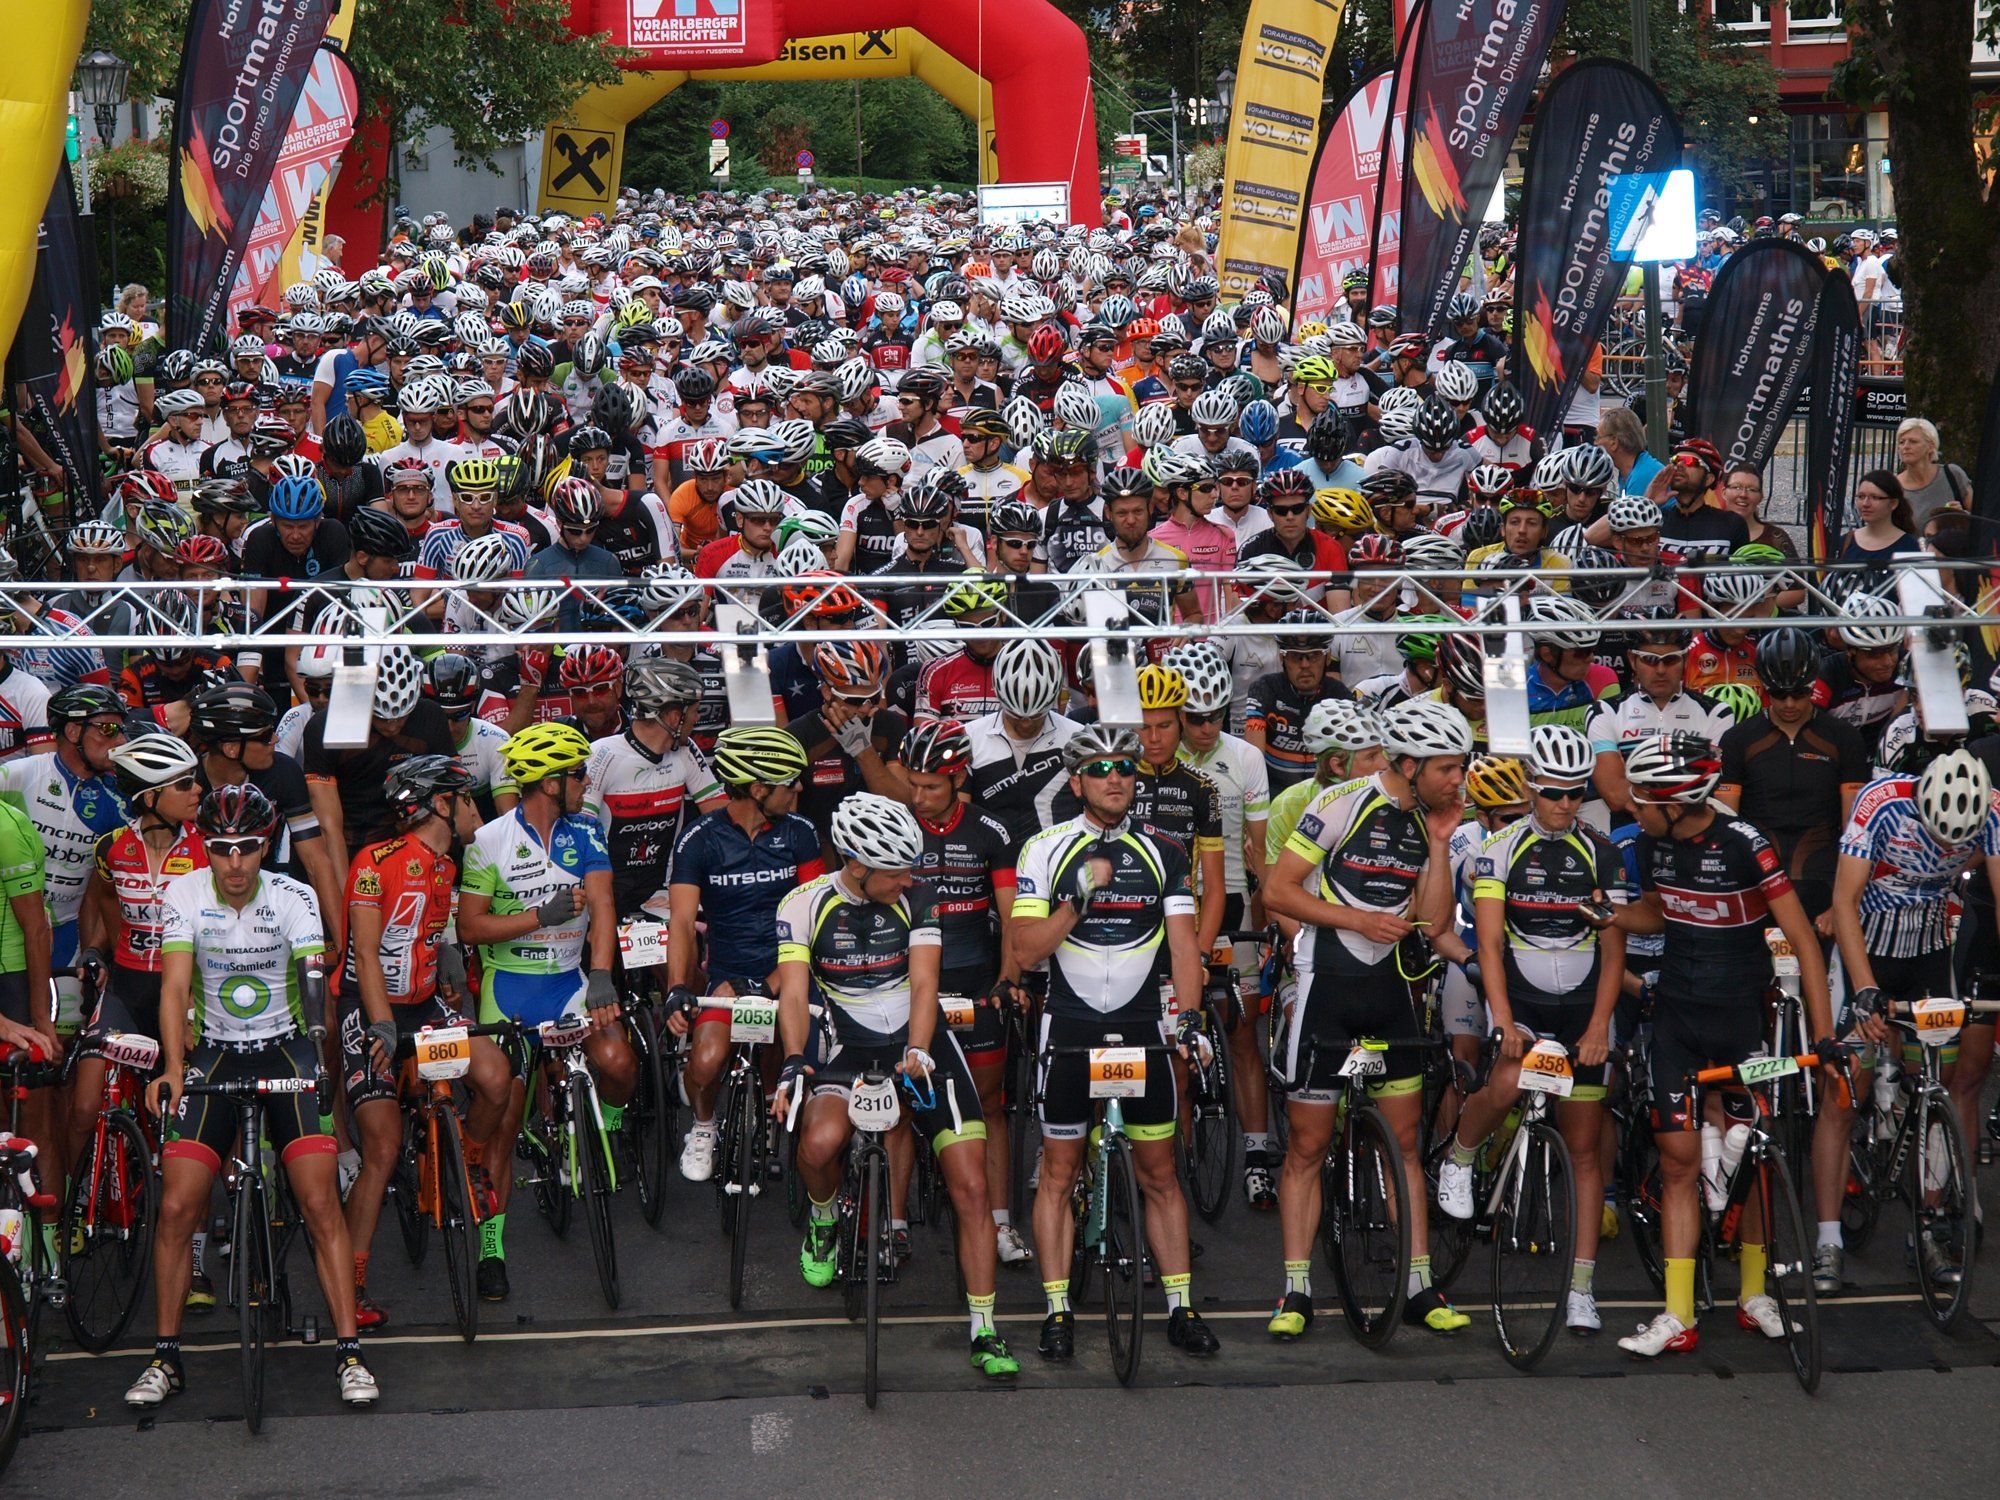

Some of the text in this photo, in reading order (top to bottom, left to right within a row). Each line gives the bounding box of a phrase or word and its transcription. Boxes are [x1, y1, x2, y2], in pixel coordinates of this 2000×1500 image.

[633, 16, 738, 31] VORARLBERGER
[633, 29, 727, 42] NACHRICHTEN
[1262, 27, 1307, 46] VORARLBERG
[1260, 42, 1322, 72] VOL.AT
[1471, 3, 1541, 158] Die ganze Dimension
[236, 151, 253, 178] Die
[249, 104, 269, 151] ganze
[261, 22, 300, 103] Dimension
[1246, 105, 1313, 127] VORARLBERG ONLINE
[1245, 119, 1310, 145] VOL.AT
[1560, 112, 1600, 212] Hohenems
[1276, 191, 1298, 202] ONLINE
[1552, 121, 1637, 327] sportmathis
[1571, 113, 1663, 335] Die ganze Dimension des Sports.
[1731, 291, 1773, 377] Hohenems
[1723, 298, 1804, 475] sportmathis
[1752, 423, 1773, 460] ganze
[1766, 357, 1801, 421] Dimension
[1798, 333, 1811, 356] des
[1073, 542, 1100, 551] tour
[36, 796, 66, 812] Vision
[510, 860, 542, 872] Vision
[708, 865, 797, 887] RITSCHIS
[947, 902, 974, 912] GOLD
[1660, 892, 1730, 921] Tirol
[637, 934, 664, 947] 1062
[207, 958, 277, 972] BergSchmiede
[733, 1008, 774, 1026] 2053
[1925, 1012, 1956, 1028] 404
[114, 1048, 151, 1064] 1044
[428, 1042, 459, 1061] 860
[1102, 1063, 1134, 1080] 846
[1349, 1059, 1385, 1076] 2309
[1534, 1054, 1566, 1074] 358
[1749, 1058, 1790, 1079] 2227
[279, 1079, 309, 1091] 1096
[853, 1093, 894, 1112] 2310
